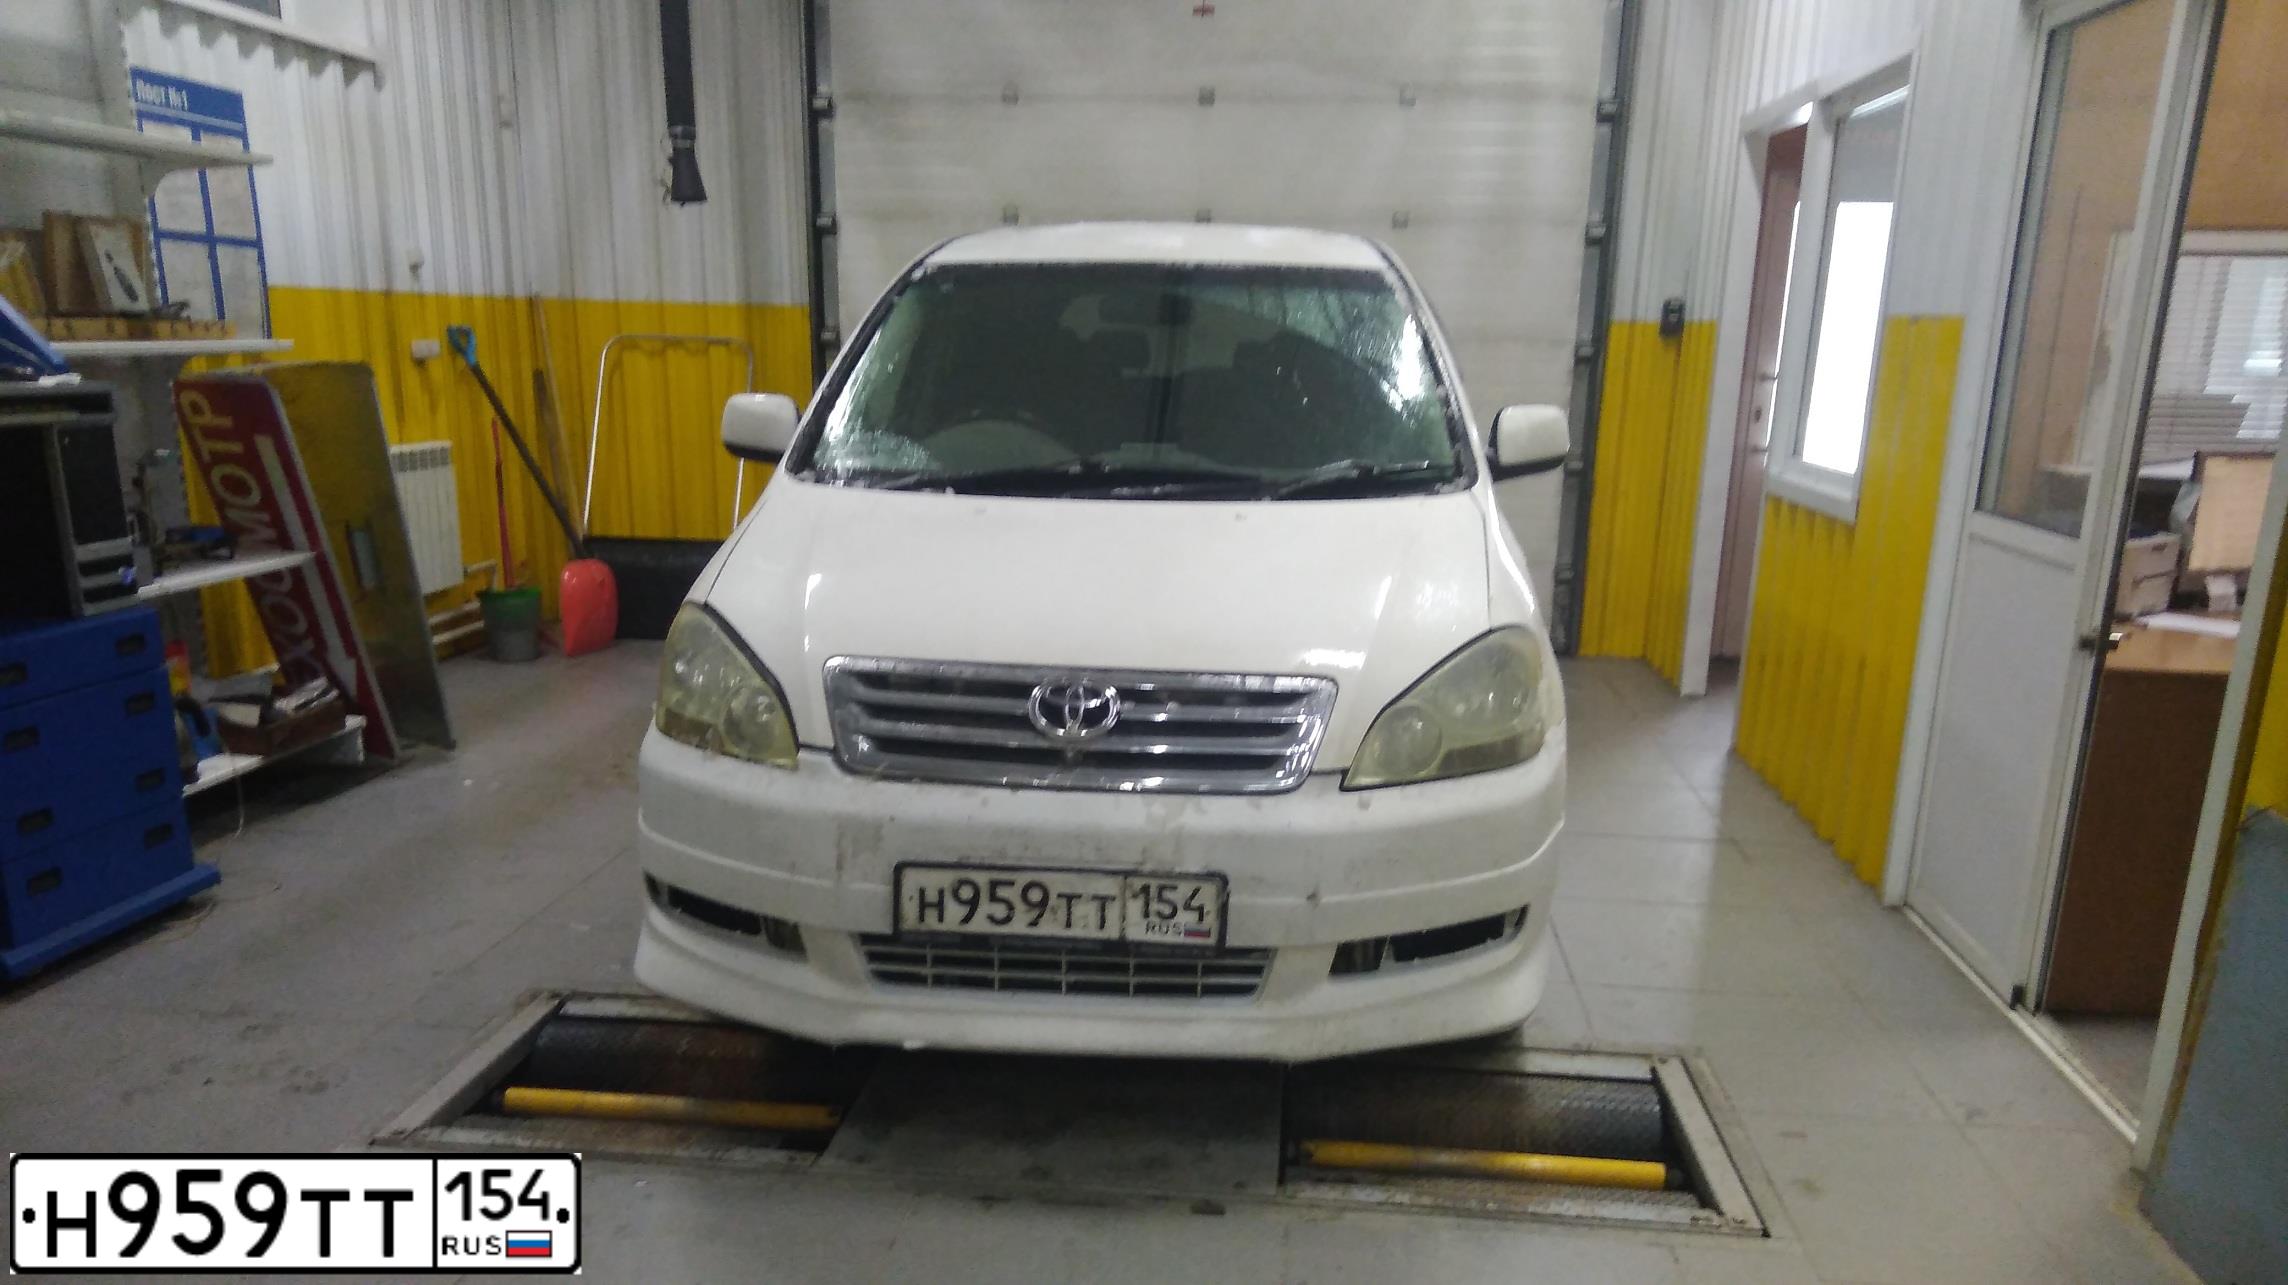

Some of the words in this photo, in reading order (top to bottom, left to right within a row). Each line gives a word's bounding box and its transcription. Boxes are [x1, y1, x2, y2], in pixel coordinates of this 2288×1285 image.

[179, 389, 324, 678] ХОСМОТР
[917, 878, 1117, 930] Н959ТТ
[1131, 883, 1205, 922] 154
[1145, 921, 1182, 936] RUS
